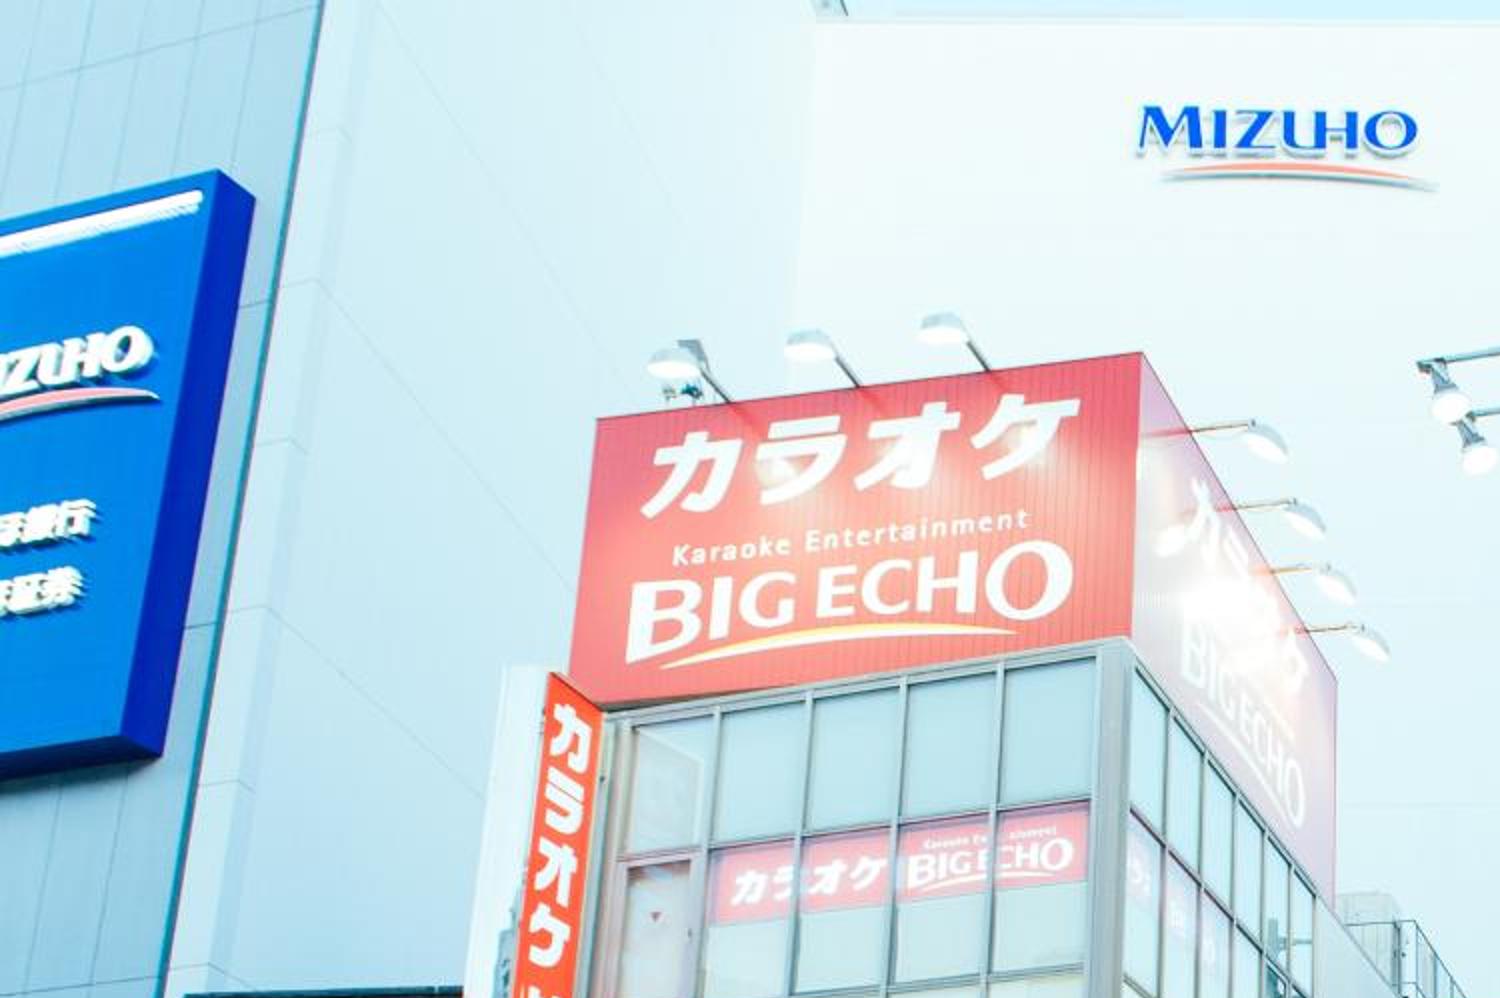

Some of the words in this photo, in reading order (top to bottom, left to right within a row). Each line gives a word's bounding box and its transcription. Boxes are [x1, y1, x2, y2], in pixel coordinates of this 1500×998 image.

[1136, 105, 1420, 158] MIZUHO
[0, 326, 154, 400] ZUHO
[640, 392, 1082, 519] カラオケ
[672, 536, 791, 567] Karaoke
[804, 508, 1030, 553] Entertainment
[625, 572, 796, 666] BIG
[814, 539, 1075, 621] ECHO
[528, 702, 593, 971] カラオケ
[730, 855, 888, 906] カラオケ
[906, 850, 973, 891] BIG
